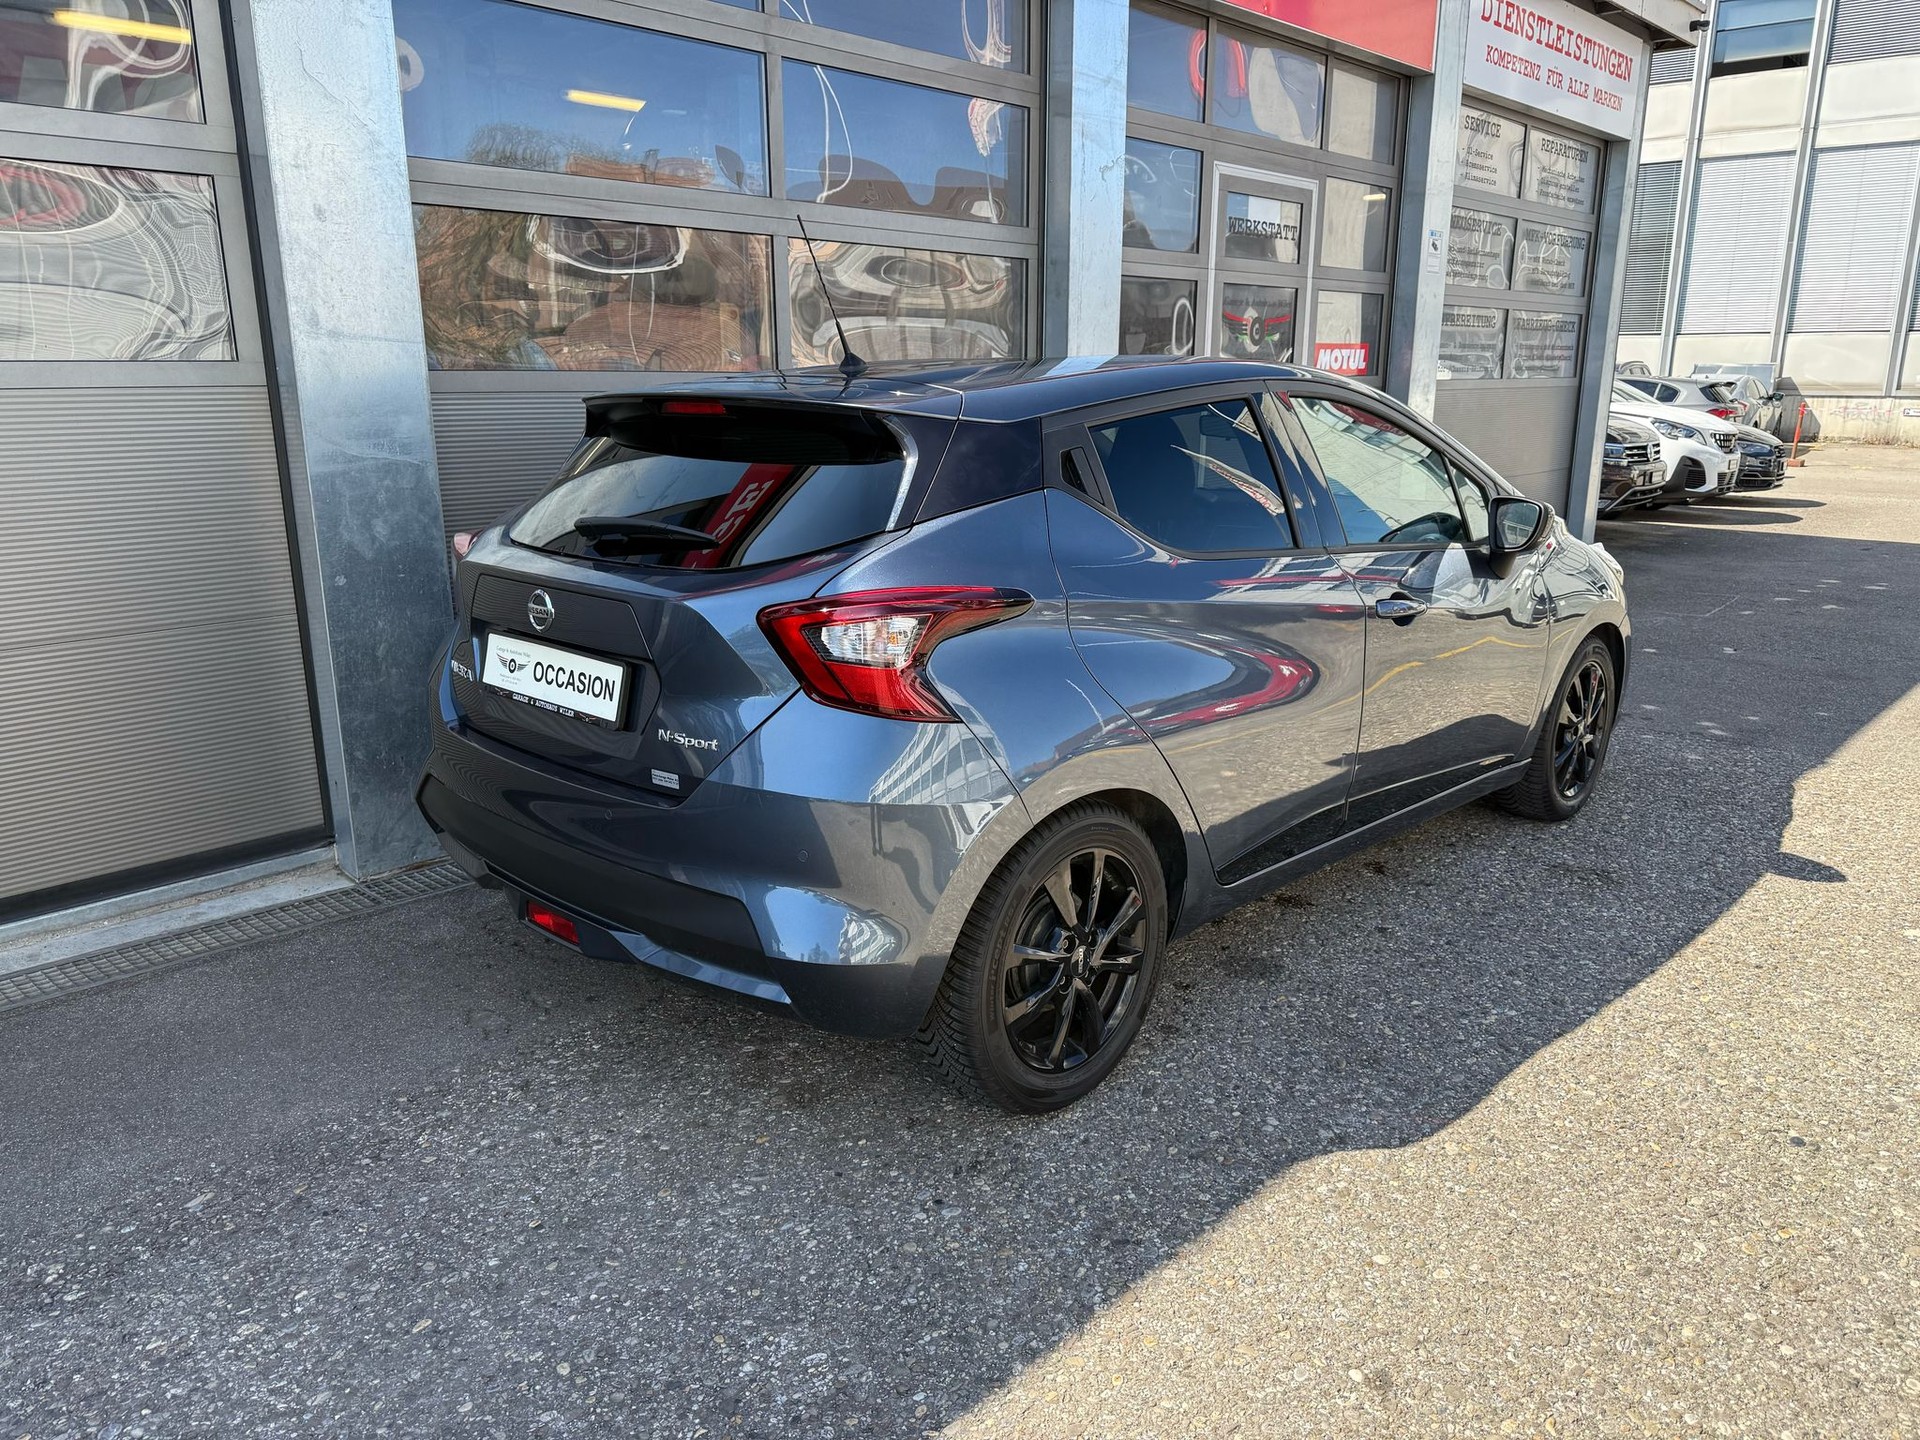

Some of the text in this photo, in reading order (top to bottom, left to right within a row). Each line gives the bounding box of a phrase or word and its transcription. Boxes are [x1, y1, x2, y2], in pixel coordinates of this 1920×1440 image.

[1481, 0, 1633, 82] DIENSTLEISTUNGEN
[1485, 45, 1623, 112] KOMPETENZ FÜR ALLE MARKEN
[1464, 115, 1501, 138] SERVICE
[1540, 138, 1589, 163] REPARATUREN
[1228, 216, 1297, 241] WERKSTATT
[1316, 349, 1367, 370] MOTUL
[533, 661, 616, 702] OCCASION
[658, 729, 719, 751] N-Sport
